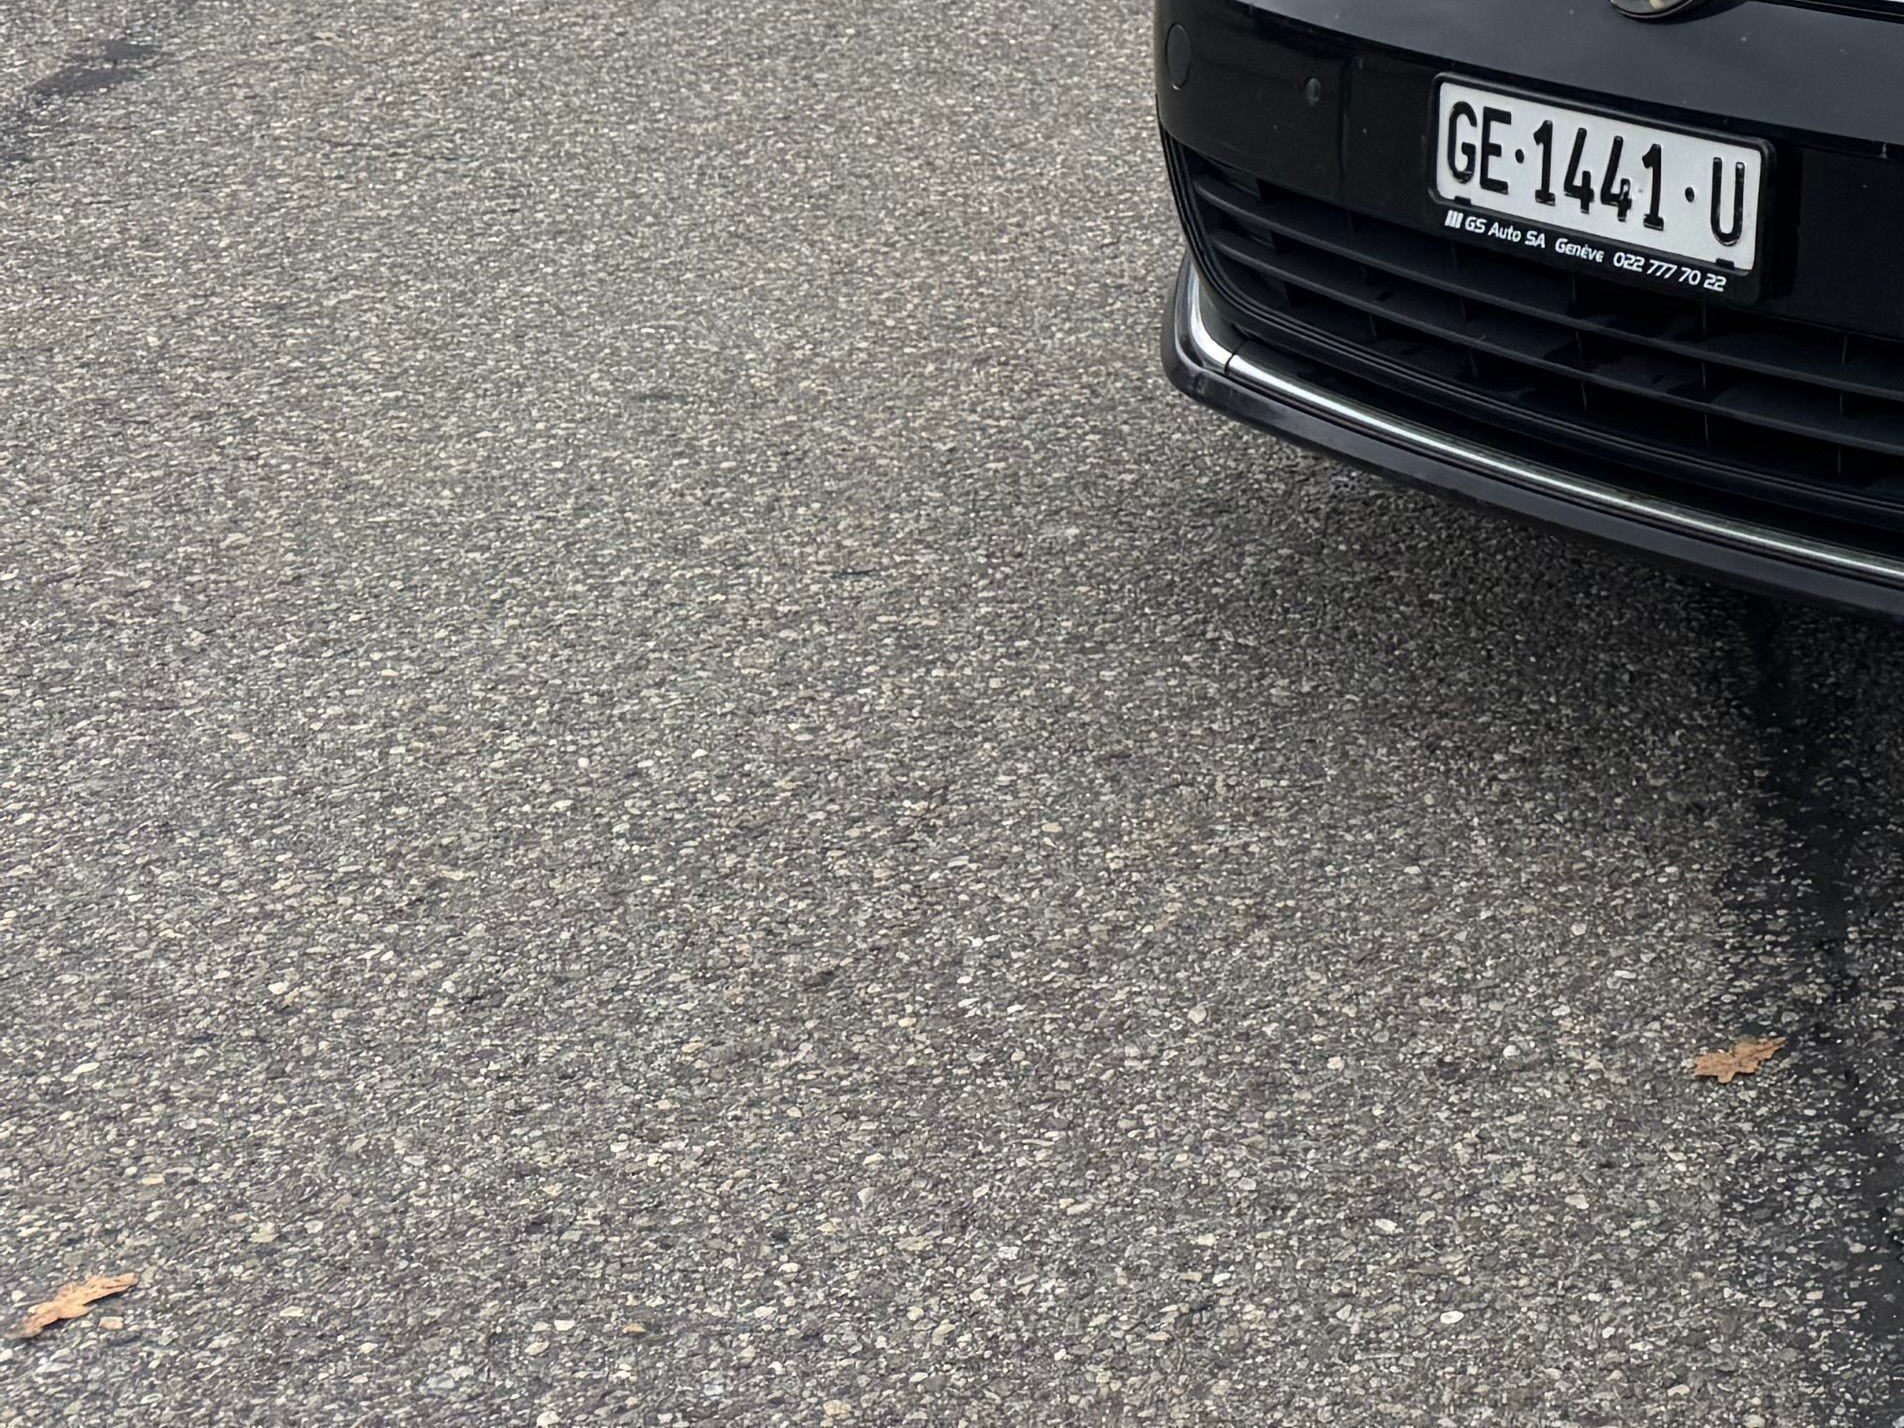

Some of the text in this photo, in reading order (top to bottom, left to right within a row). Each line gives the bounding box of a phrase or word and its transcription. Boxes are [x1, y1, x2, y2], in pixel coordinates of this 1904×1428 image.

[1464, 216, 1727, 293] GS Auto SA Genève 022 777 70 22
